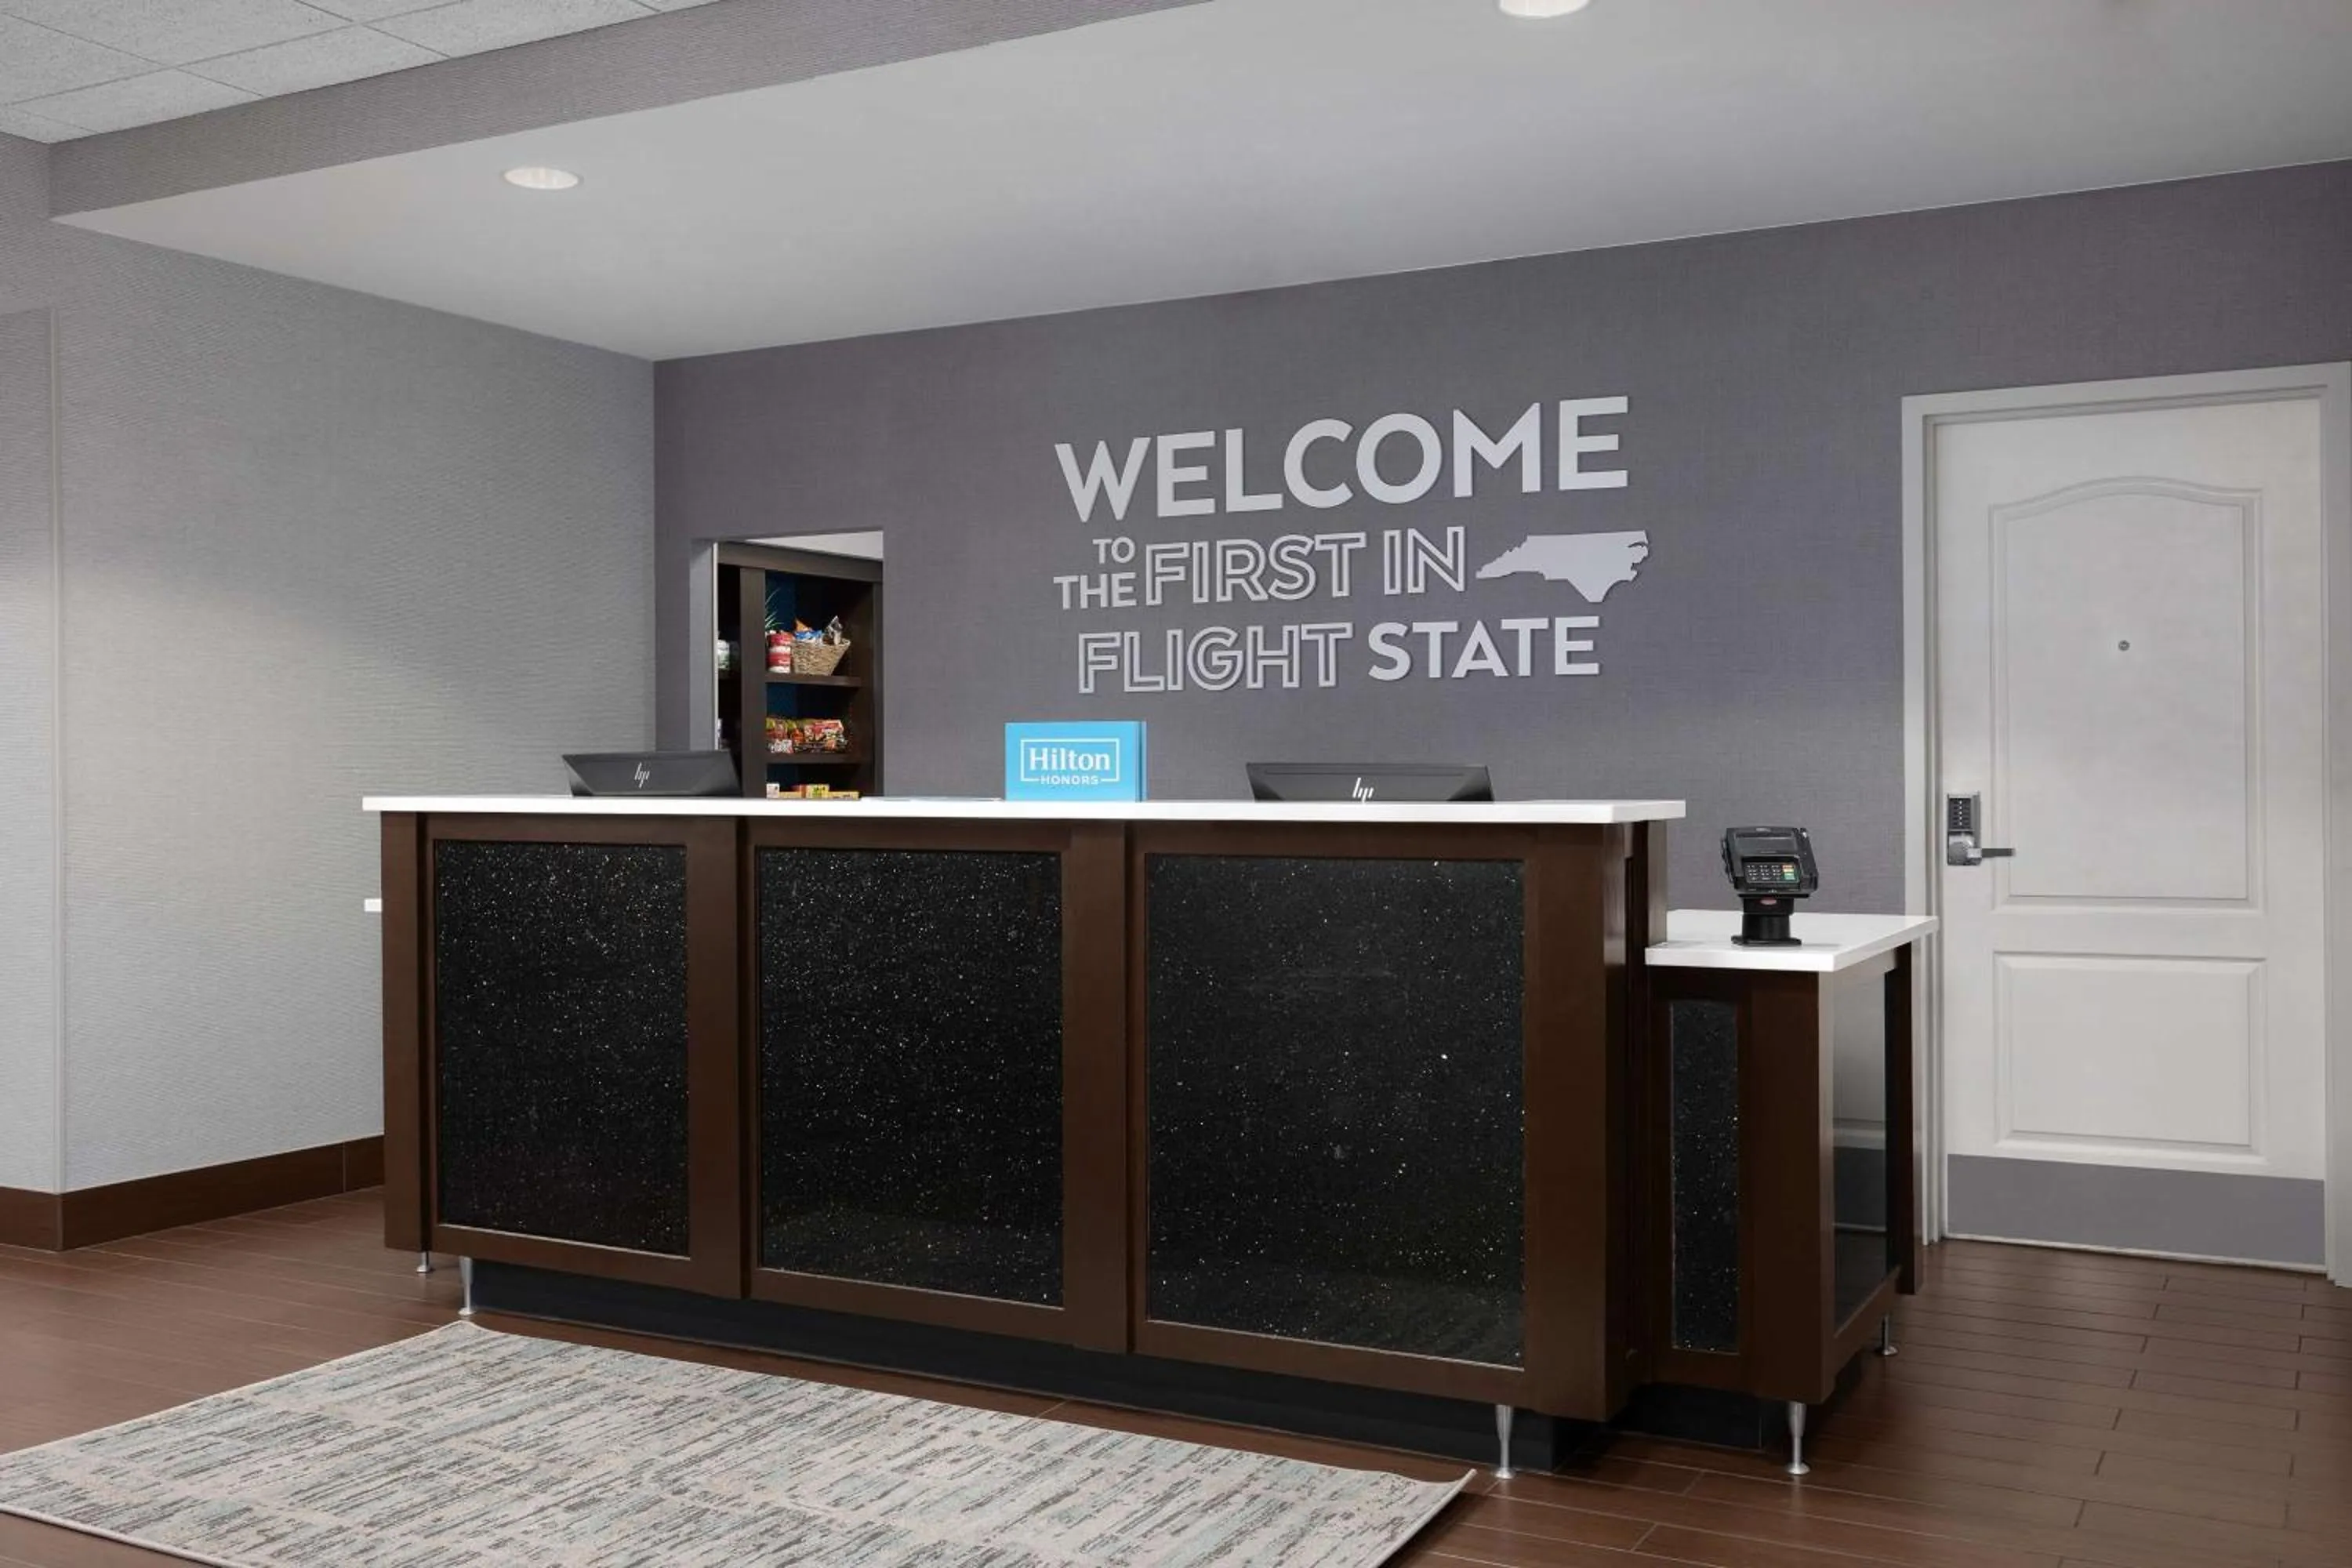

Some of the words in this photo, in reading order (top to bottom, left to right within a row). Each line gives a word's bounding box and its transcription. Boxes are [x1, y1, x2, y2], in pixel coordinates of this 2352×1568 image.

[1054, 396, 1628, 523] WELCOME
[1093, 536, 1134, 564] TO
[1145, 532, 1367, 606] FIRST
[1383, 526, 1465, 596] IN
[1053, 571, 1137, 610] THE
[1078, 622, 1354, 694] FLIGHT
[1367, 615, 1601, 681] STATE
[1029, 747, 1111, 771] Hilton
[634, 762, 650, 789] hp
[1040, 775, 1099, 786] HONORS
[1352, 777, 1374, 803] hp
